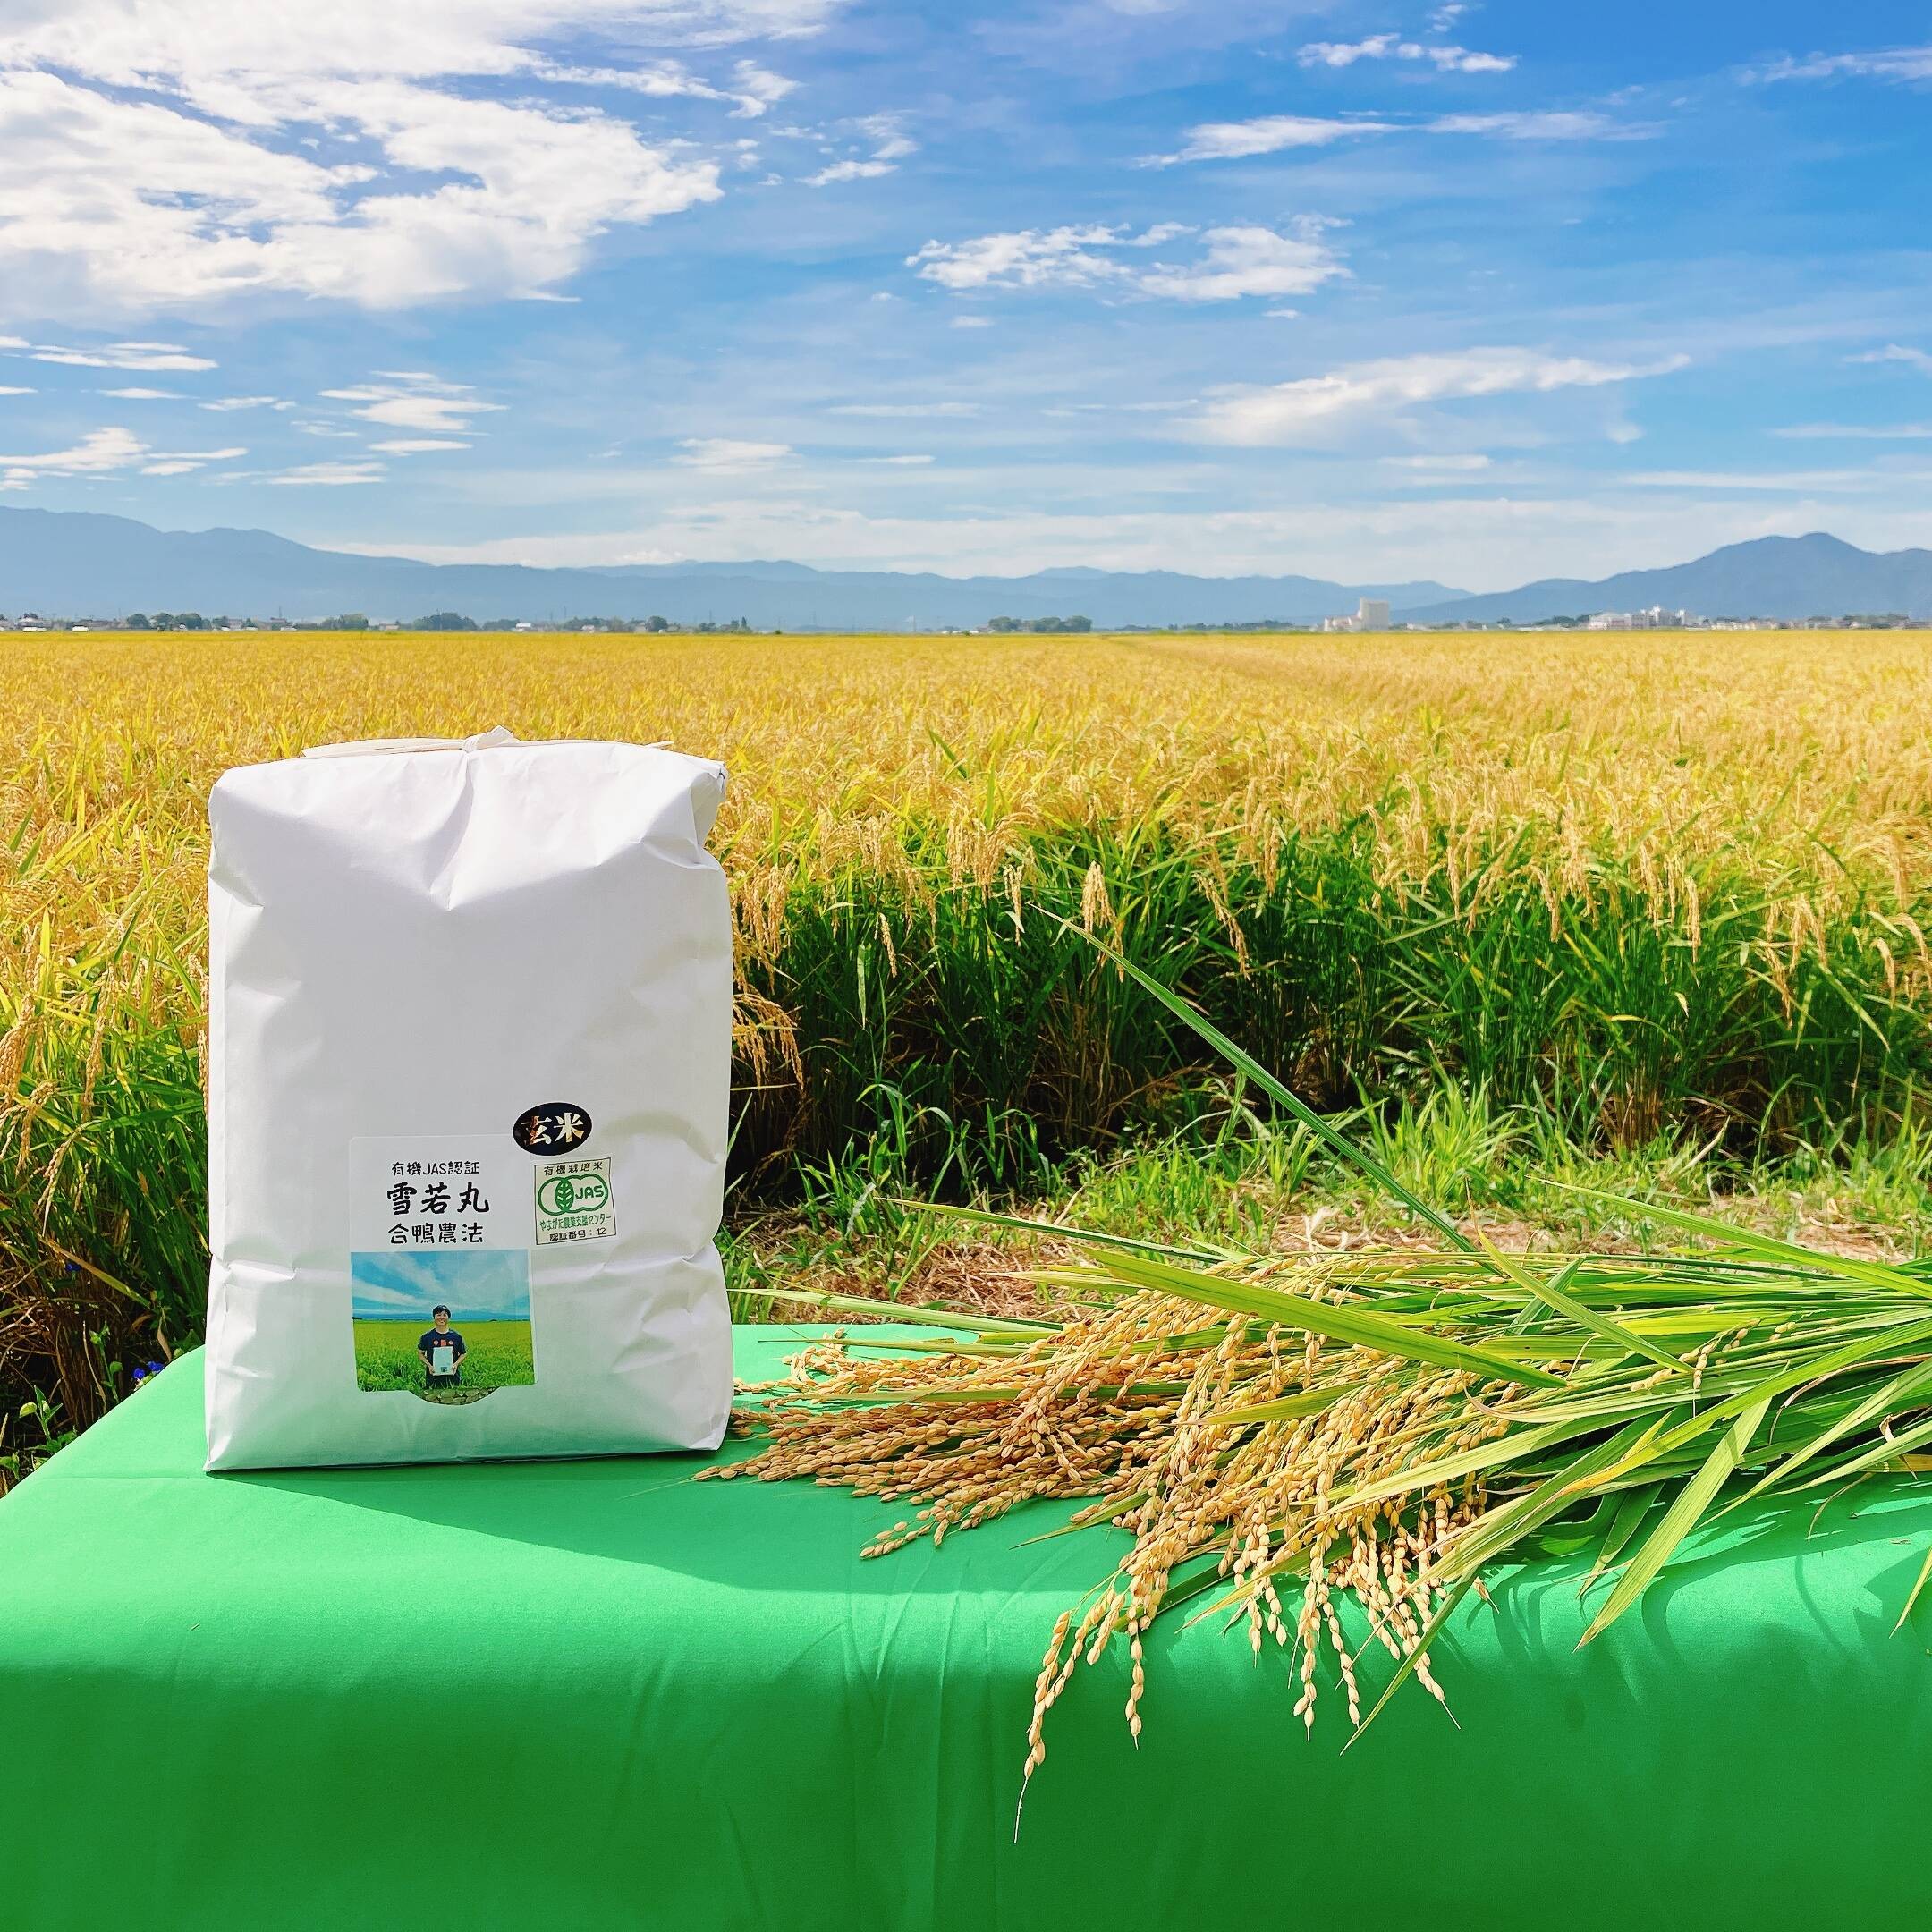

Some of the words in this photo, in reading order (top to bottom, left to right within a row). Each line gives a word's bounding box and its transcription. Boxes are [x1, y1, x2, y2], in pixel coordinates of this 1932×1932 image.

[520, 1112, 584, 1146] 玄米
[391, 1162, 480, 1176] 有機JAS認証
[543, 1162, 603, 1176] 有機栽培米
[386, 1182, 490, 1216] 雪若丸
[574, 1185, 605, 1200] JAS
[387, 1222, 484, 1245] 合鴨農法
